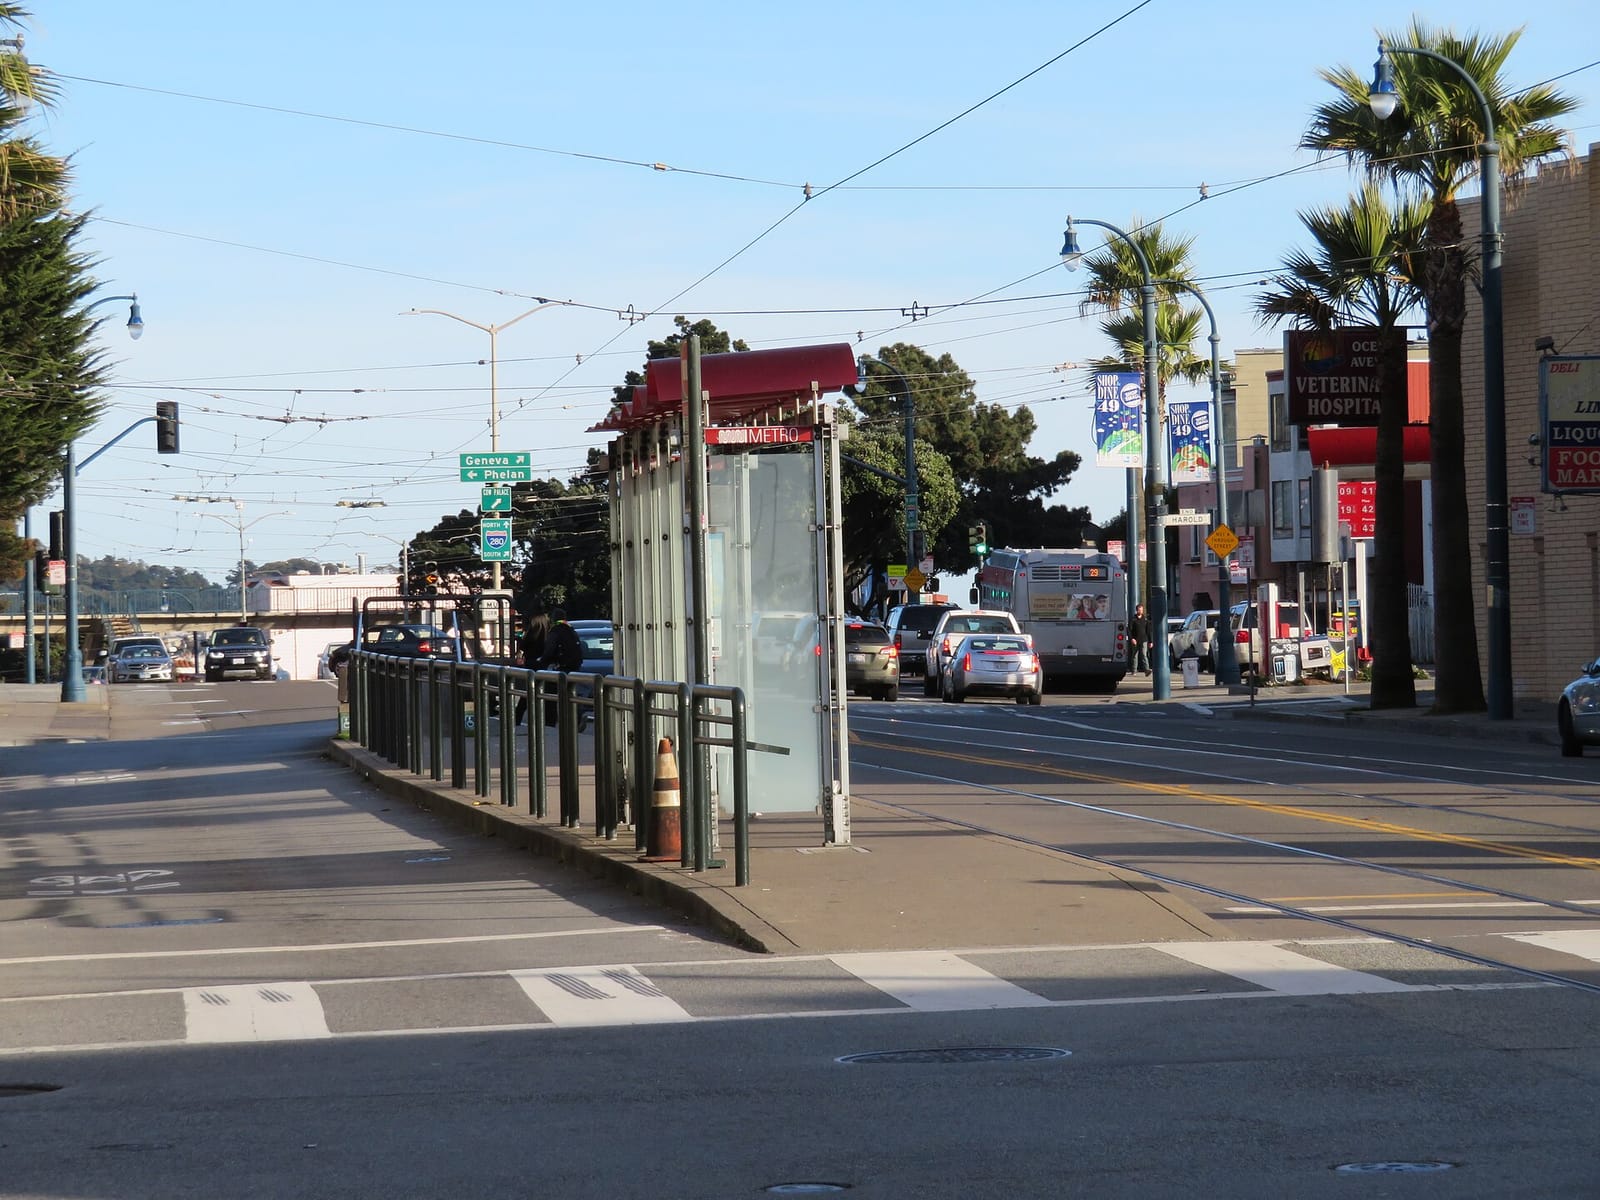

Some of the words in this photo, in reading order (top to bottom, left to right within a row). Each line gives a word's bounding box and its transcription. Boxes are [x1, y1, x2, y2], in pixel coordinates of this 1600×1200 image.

[1352, 341, 1380, 352] OCE
[1350, 357, 1378, 367] AVE
[1550, 363, 1579, 373] DELI
[1097, 374, 1119, 386] SHOP
[1296, 376, 1380, 393] VETERINA
[1097, 386, 1119, 400] DINE
[1097, 400, 1120, 413] 49
[1170, 403, 1190, 414] SHOP
[1307, 398, 1381, 415] HOSPITA
[1171, 413, 1191, 425] DINE
[749, 428, 799, 443] METRO
[1173, 424, 1191, 436] 49
[1552, 427, 1600, 443] LIQU
[465, 455, 509, 466] Geneva
[484, 469, 525, 479] Phelan
[1556, 468, 1600, 483] MAR
[1361, 487, 1376, 495] 41
[1171, 516, 1204, 524] HAROLD
[489, 537, 504, 546] 280
